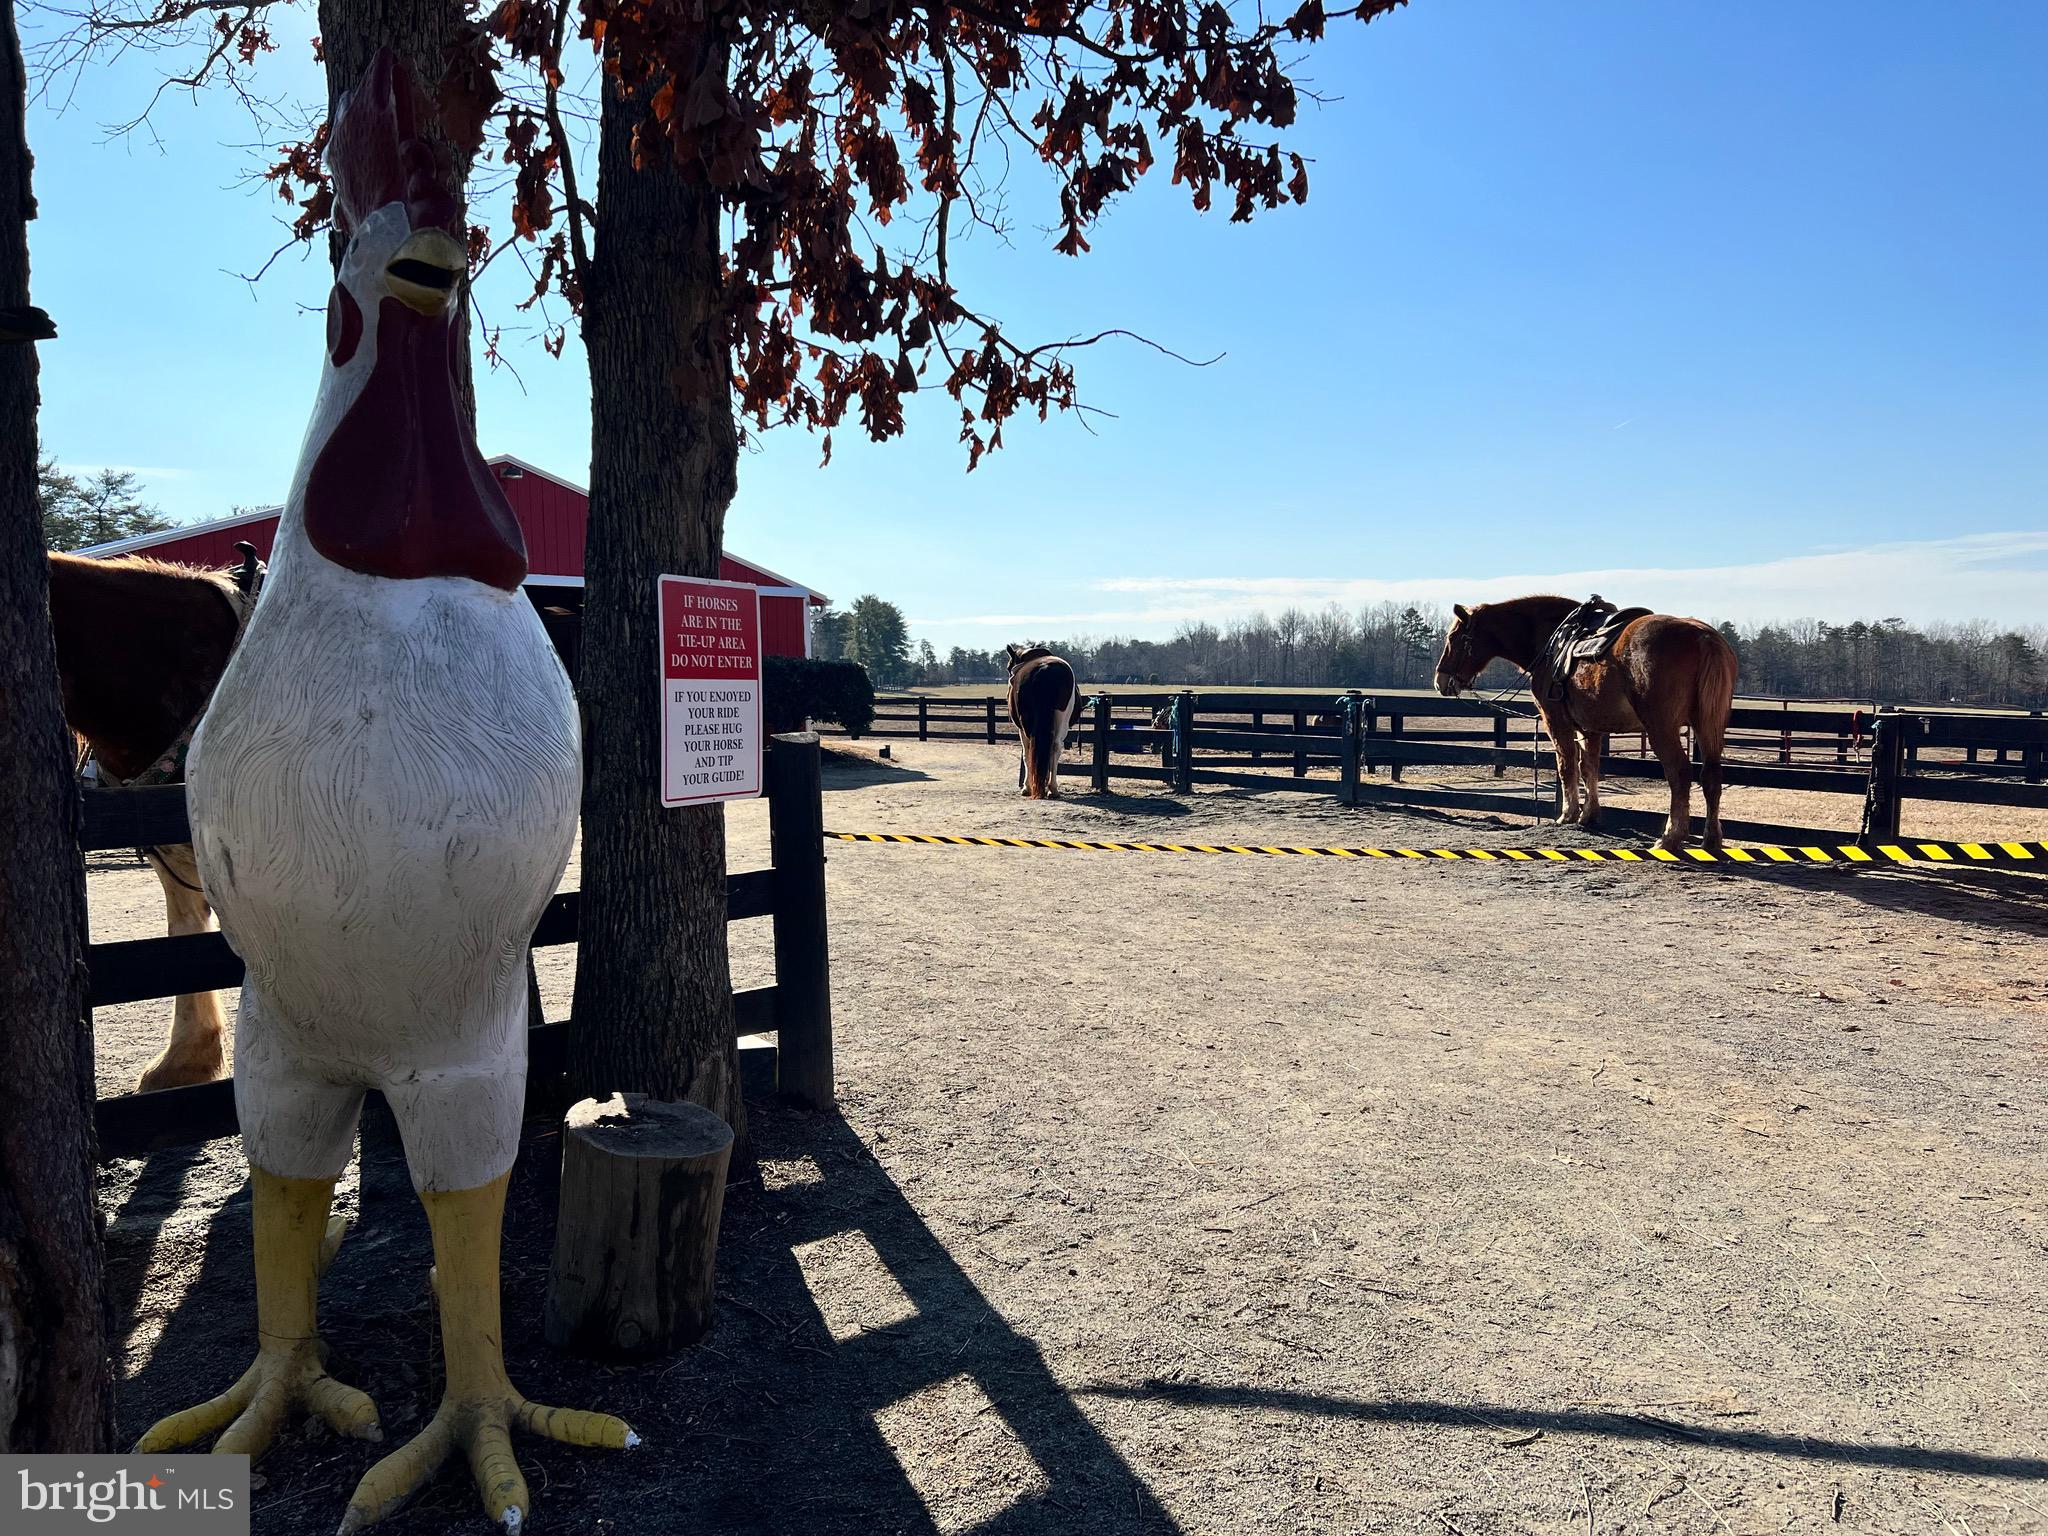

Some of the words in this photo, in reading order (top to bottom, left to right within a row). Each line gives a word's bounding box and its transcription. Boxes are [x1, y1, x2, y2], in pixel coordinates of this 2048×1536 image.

[684, 595, 694, 608] IF
[697, 596, 738, 611] HORSES
[681, 615, 703, 628] ARE
[706, 617, 717, 628] IN
[720, 617, 742, 631] THE
[678, 634, 715, 648] TIE-UP
[718, 637, 746, 649] AREA
[672, 654, 688, 667] DO
[691, 655, 715, 667] NOT
[718, 656, 752, 668] ENTER
[675, 691, 684, 702] IF
[687, 691, 707, 702] YOU
[710, 691, 751, 702] ENJOYED
[688, 708, 715, 719] YOUR
[717, 707, 739, 718] RIDE
[685, 724, 720, 735] PLEASE
[722, 723, 742, 734] HUG
[684, 741, 711, 752] YOUR
[713, 739, 743, 750] HORSE
[695, 757, 715, 768] AND
[718, 755, 733, 766] TIP
[683, 773, 709, 785] YOUR
[712, 770, 744, 782] GUIDE!
